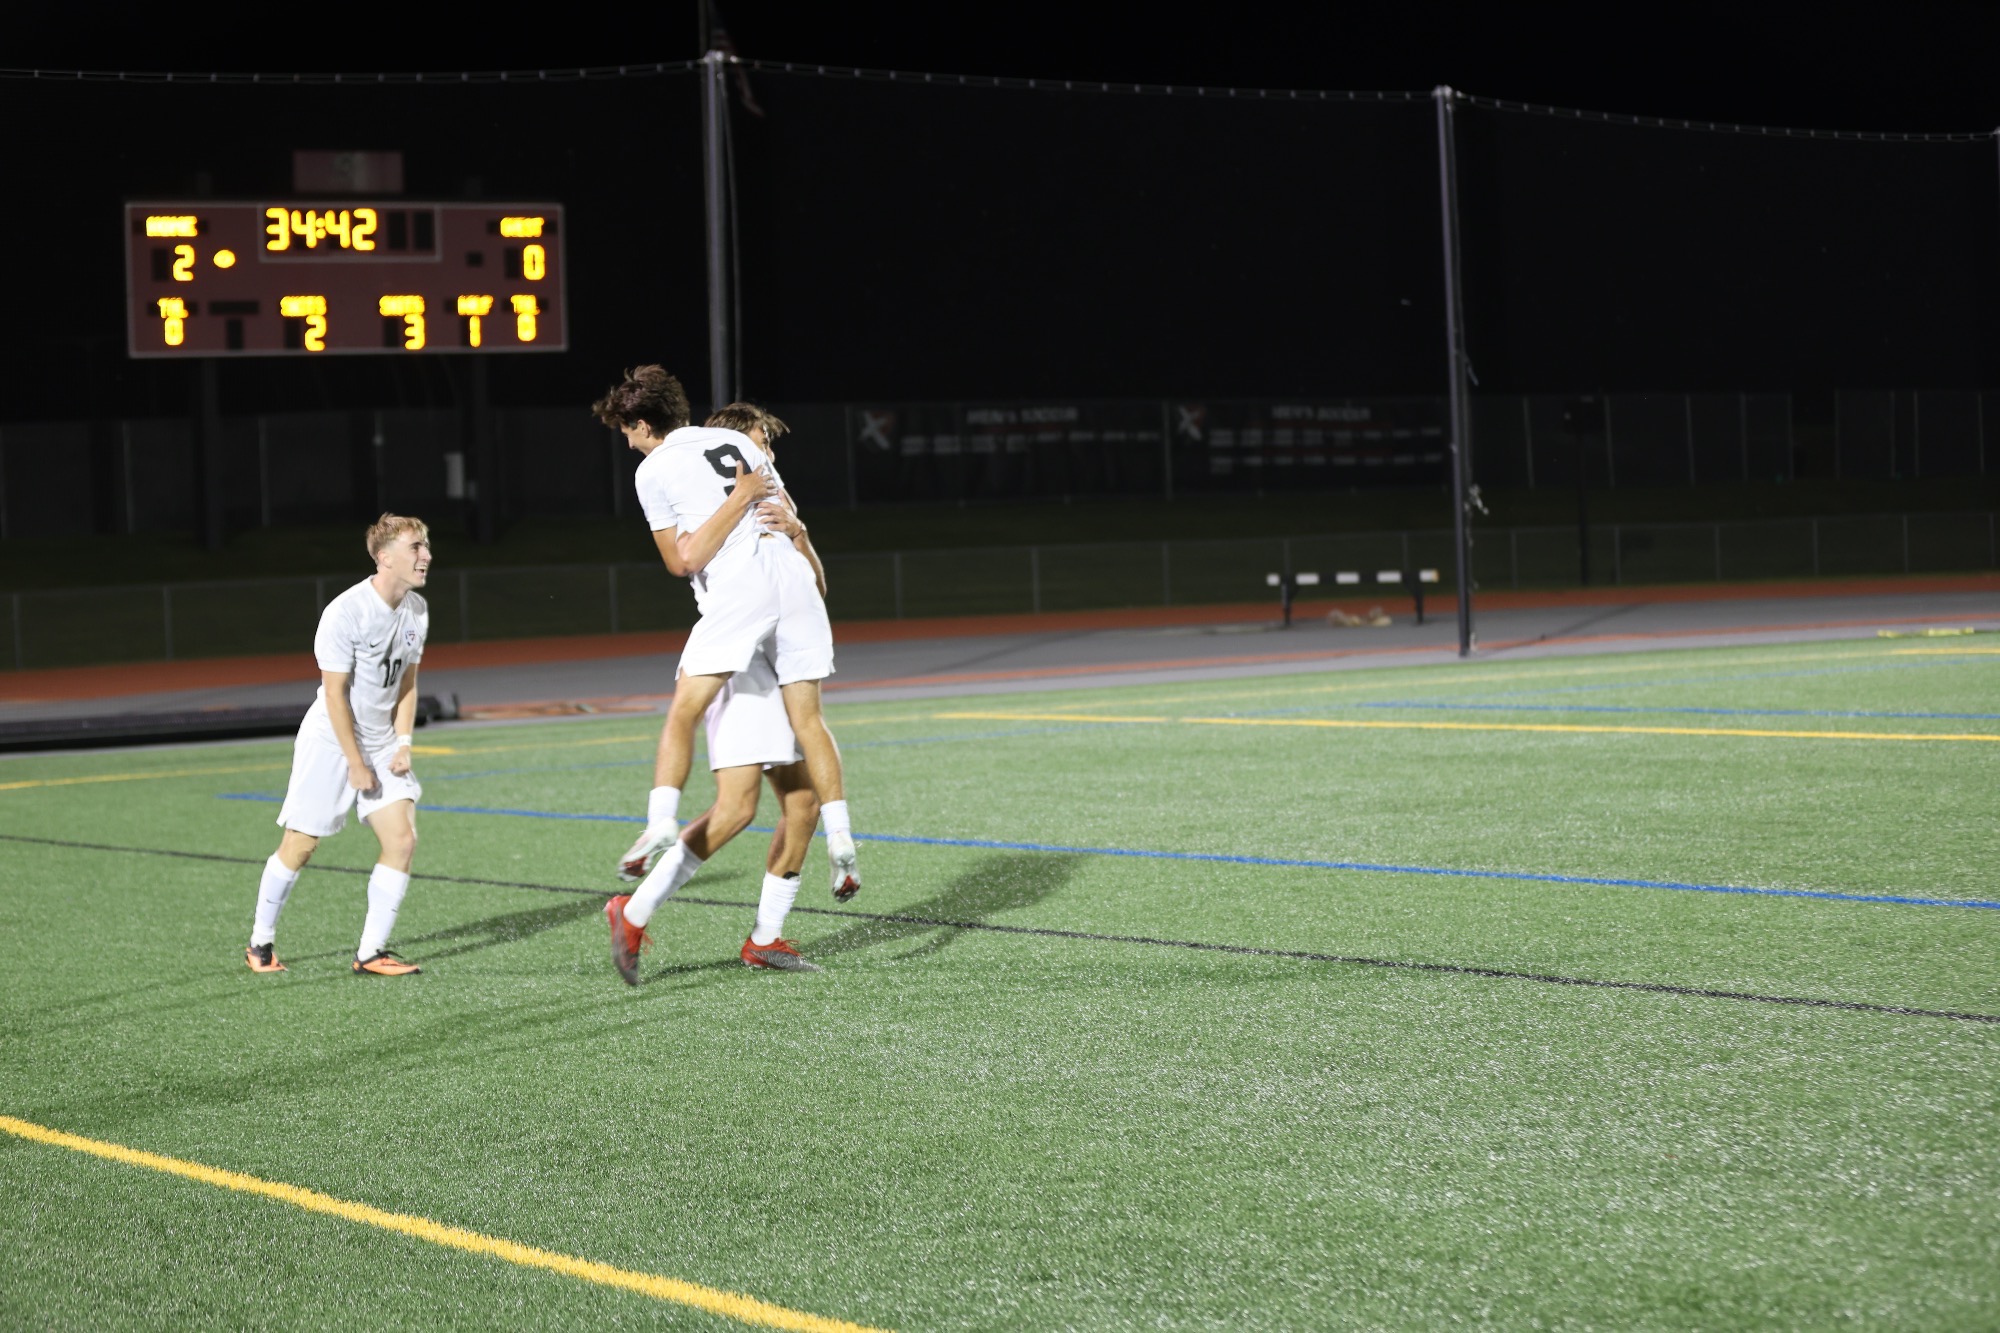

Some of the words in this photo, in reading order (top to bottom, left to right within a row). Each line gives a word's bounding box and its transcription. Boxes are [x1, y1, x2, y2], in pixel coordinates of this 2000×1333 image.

[266, 208, 377, 251] 34:42
[173, 245, 195, 281] 2
[523, 245, 545, 281] 0
[165, 317, 183, 346] 0
[305, 315, 327, 351] 2
[404, 314, 425, 350] 3
[469, 315, 481, 347] 1
[703, 443, 752, 497] 9
